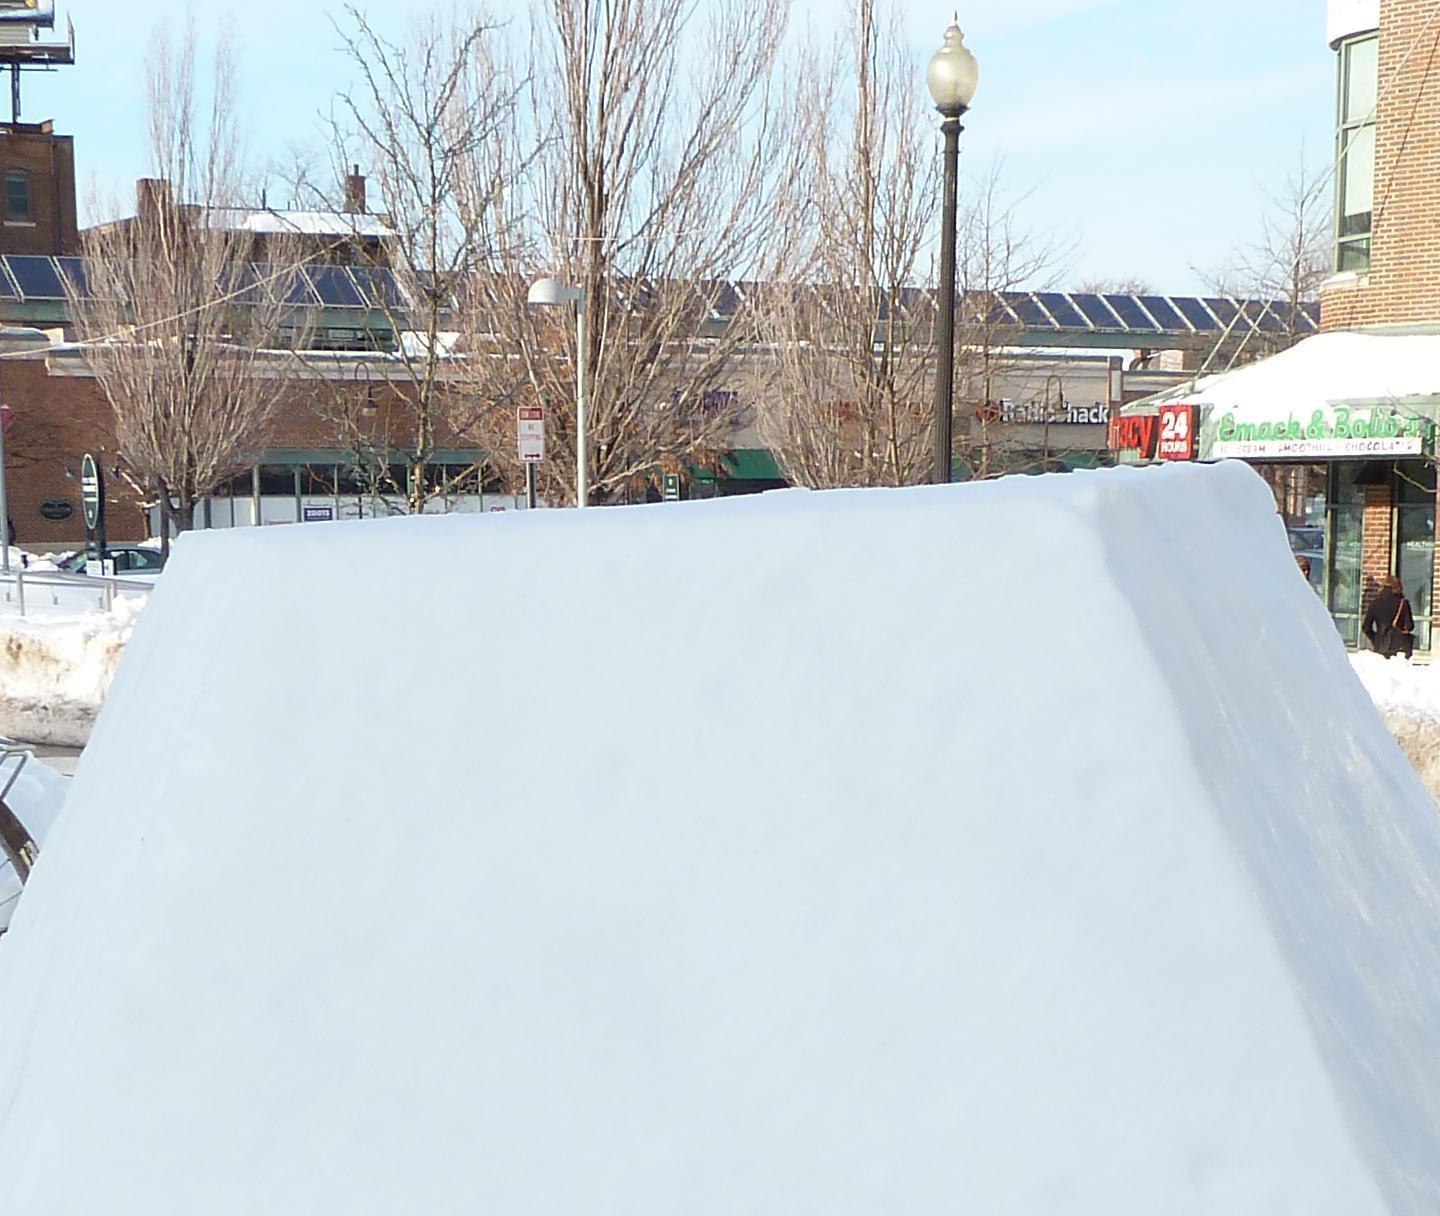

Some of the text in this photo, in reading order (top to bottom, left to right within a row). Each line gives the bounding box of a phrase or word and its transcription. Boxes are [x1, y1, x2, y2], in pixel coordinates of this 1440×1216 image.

[1002, 397, 1109, 424] Radiohack
[1218, 411, 1300, 440] Emack
[1306, 409, 1323, 438] &
[1161, 411, 1188, 441] 24
[1161, 443, 1188, 454] HOURS
